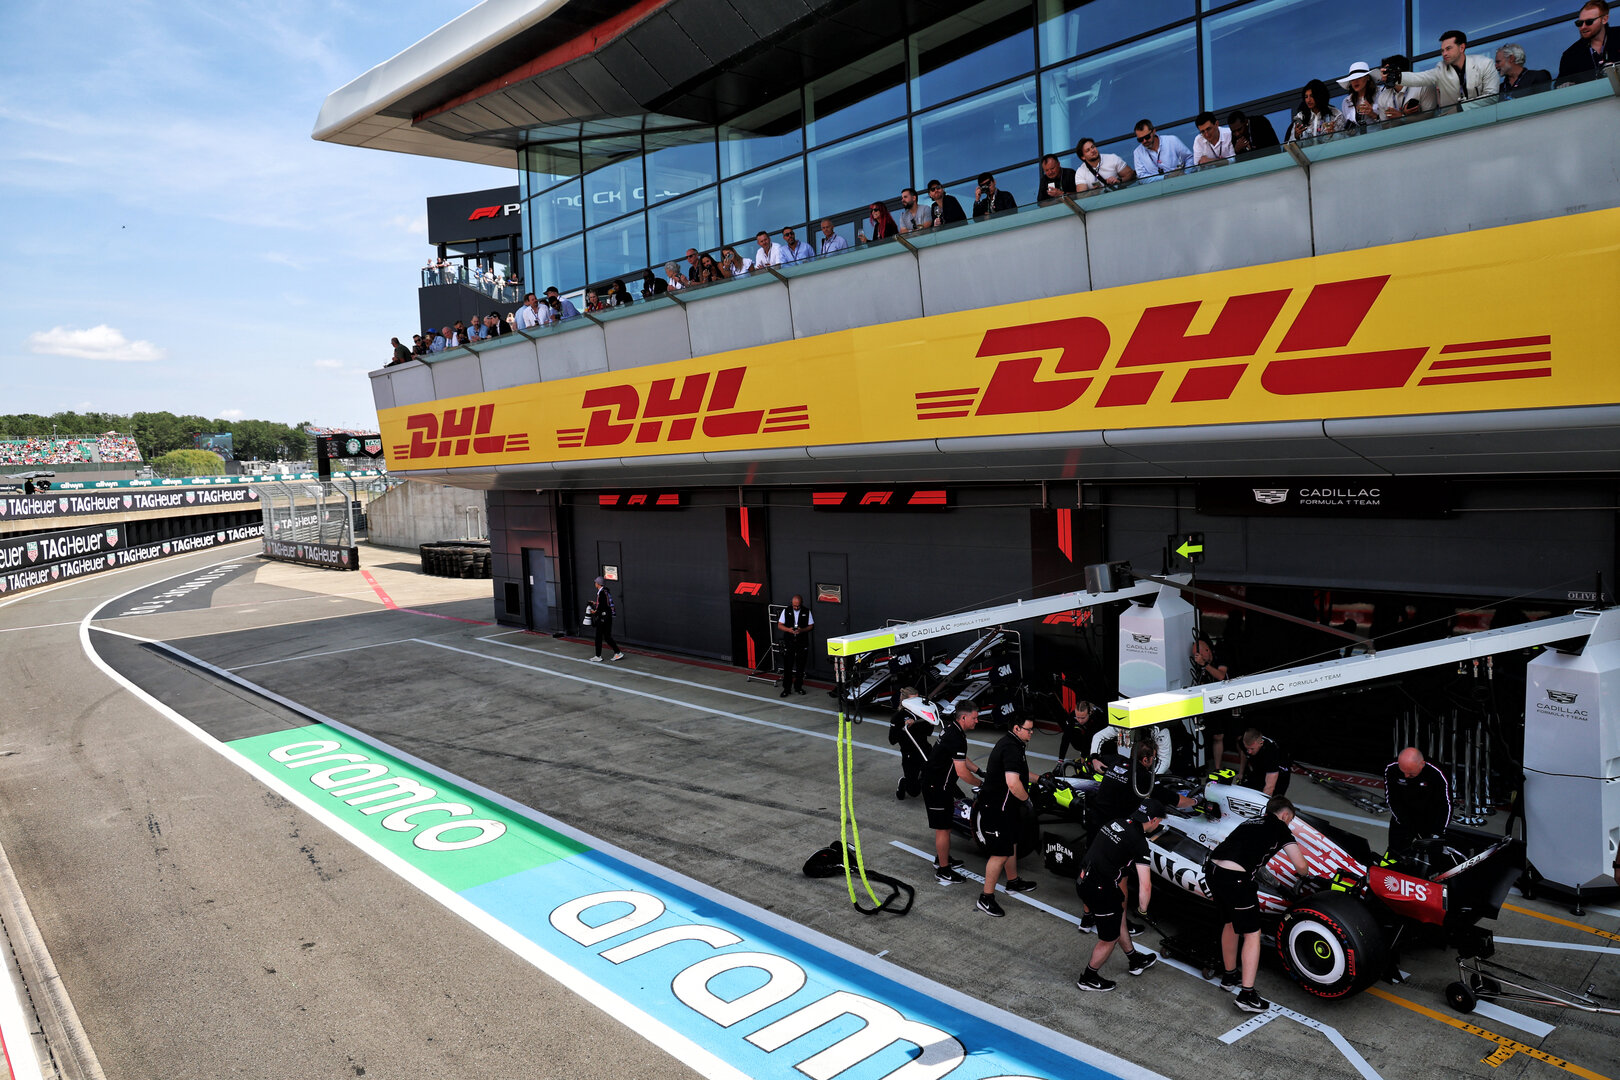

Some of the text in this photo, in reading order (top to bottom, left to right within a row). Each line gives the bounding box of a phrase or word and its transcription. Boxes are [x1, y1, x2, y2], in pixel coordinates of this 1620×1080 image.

[974, 274, 1430, 417] DHL
[581, 366, 765, 447] DHL
[406, 403, 506, 459] DHL
[1299, 488, 1381, 497] CADILLAC
[227, 524, 265, 541] TAGHeue
[911, 624, 950, 637] CADILLAC
[898, 653, 912, 666] 3M
[998, 663, 1013, 677] 3M
[1227, 682, 1285, 701] CADILLAC
[1288, 678, 1319, 688] FORMULA
[1324, 673, 1342, 682] TEAM
[1000, 702, 1015, 716] 3M
[1537, 703, 1588, 716] CADILLAC
[1537, 709, 1564, 717] FORMULA
[267, 739, 509, 853] aramco
[1045, 843, 1056, 854] JIM
[1460, 855, 1482, 871] USA
[1400, 882, 1427, 902] IFS
[548, 889, 1035, 1080] aram
